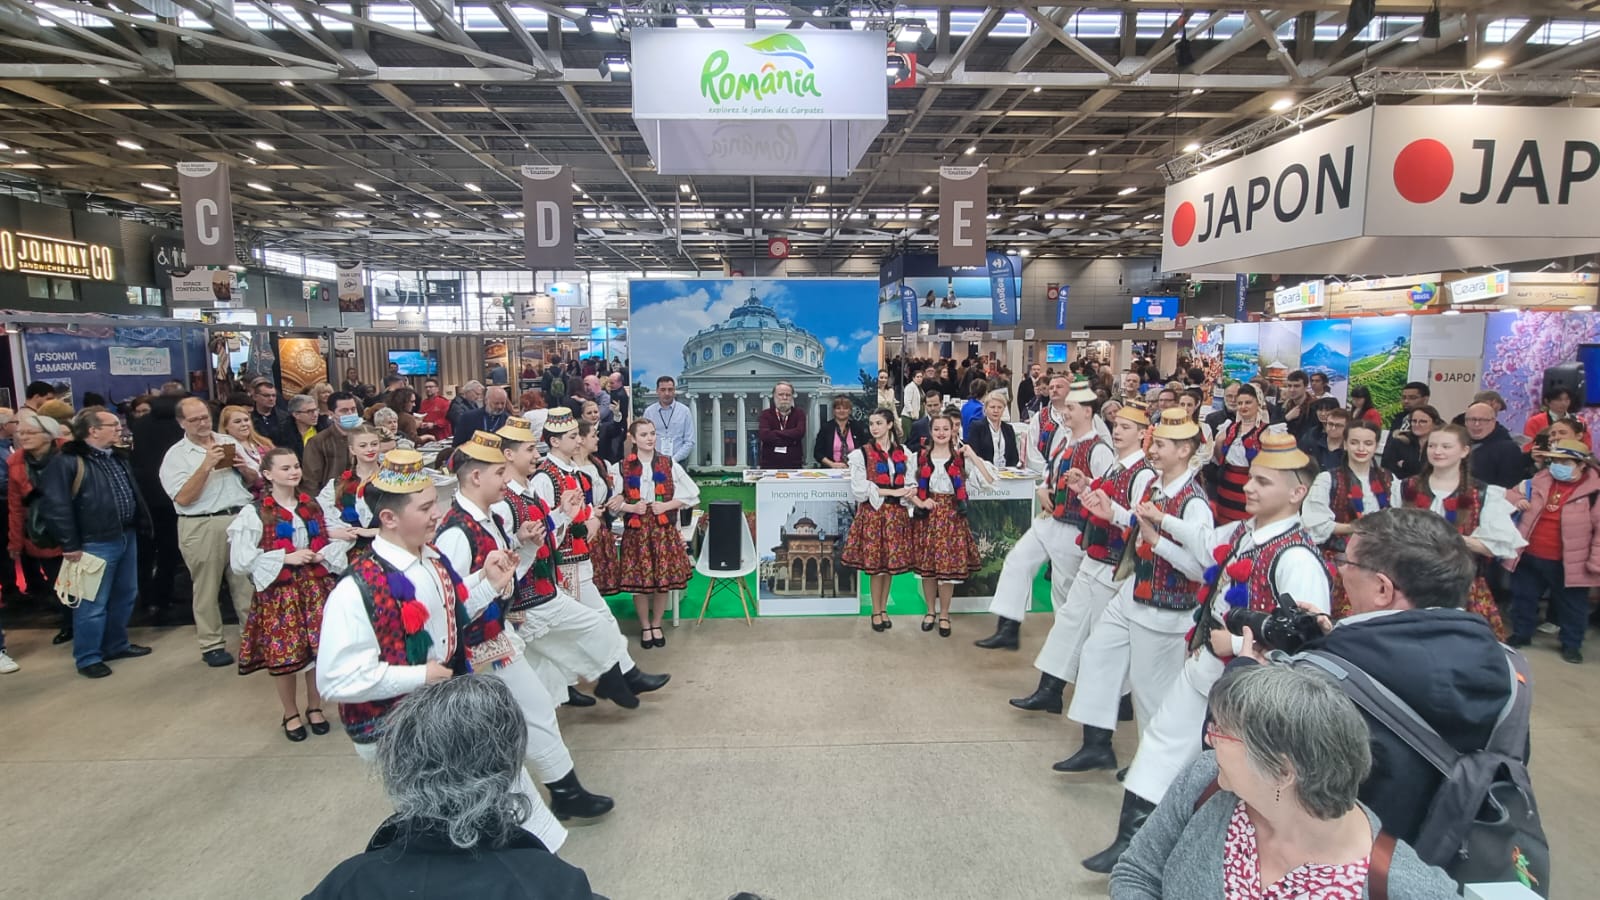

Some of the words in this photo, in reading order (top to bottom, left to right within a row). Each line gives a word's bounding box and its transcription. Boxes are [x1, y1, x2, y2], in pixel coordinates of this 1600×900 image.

[700, 49, 822, 105] România
[708, 106, 740, 115] explorez
[750, 106, 774, 115] jardin
[776, 106, 789, 114] des
[1198, 145, 1355, 243] JAPON
[1459, 139, 1600, 205] JAP
[195, 198, 220, 246] C
[536, 200, 561, 248] D
[952, 200, 974, 247] E
[0, 230, 15, 271] O
[17, 239, 88, 268] JOHNNY
[33, 352, 78, 362] AFSONAYI
[35, 361, 97, 373] SAMARKANDE
[771, 490, 809, 500] Incoming
[811, 489, 849, 499] Romania
